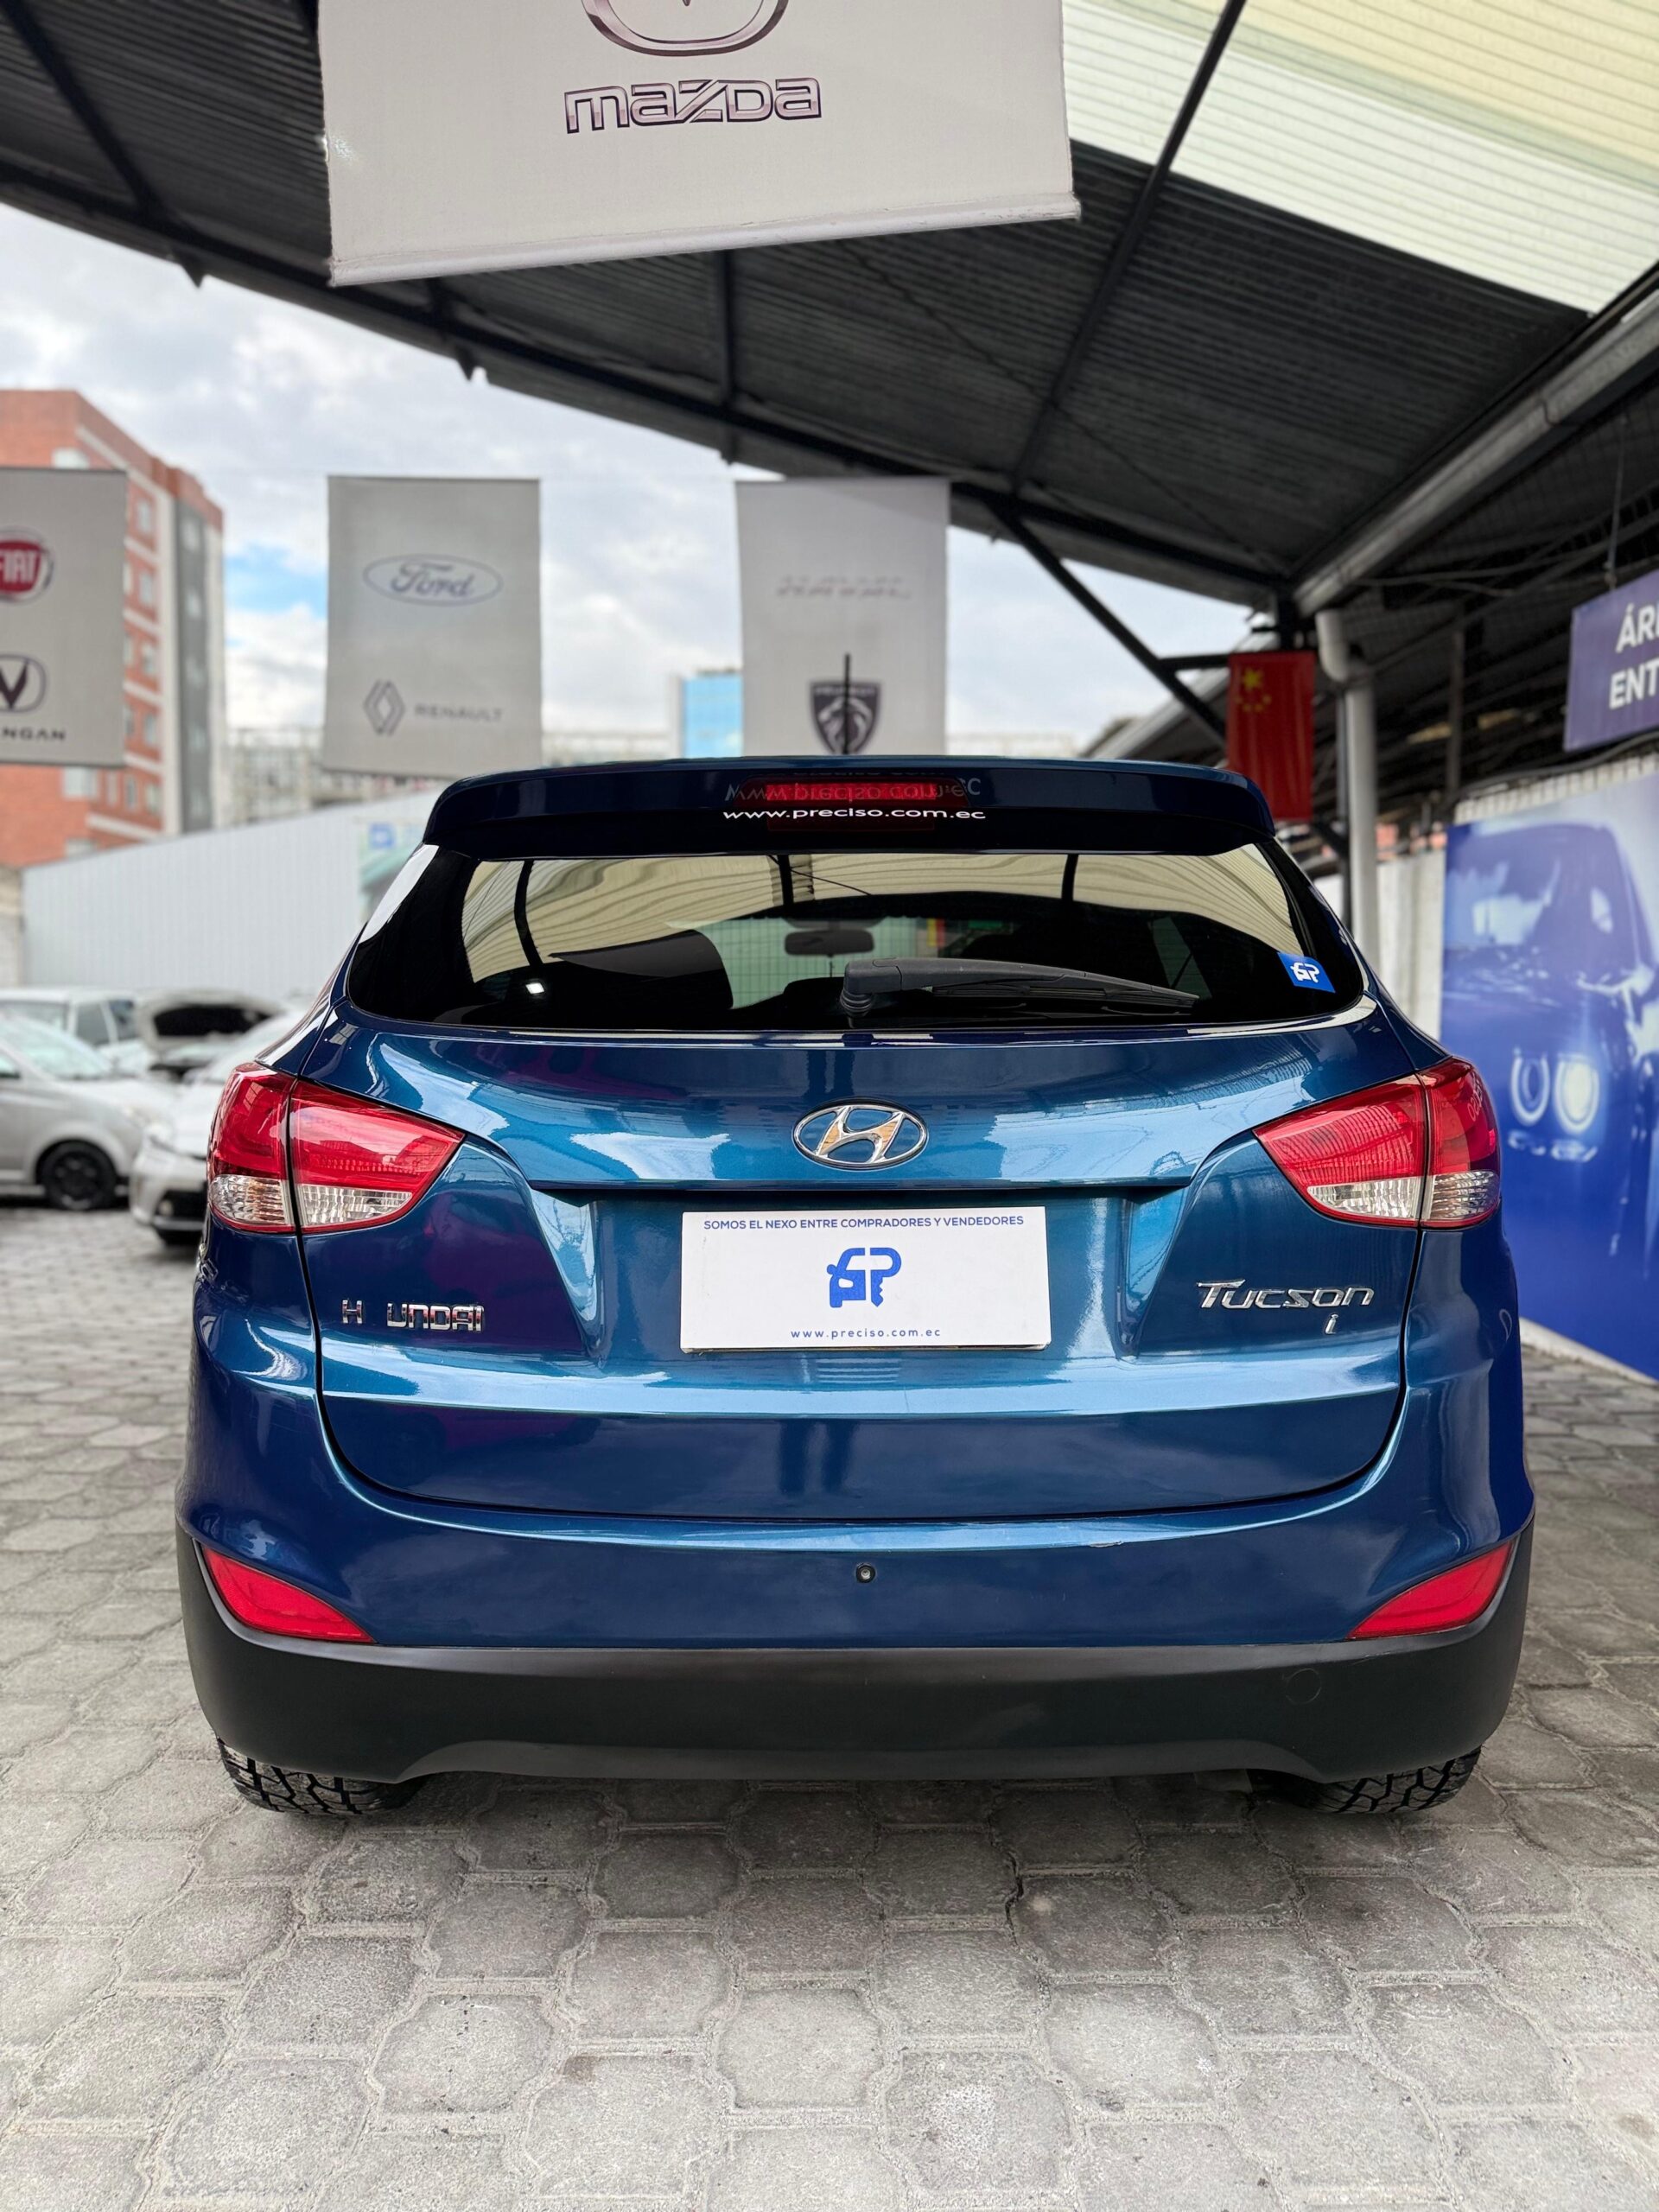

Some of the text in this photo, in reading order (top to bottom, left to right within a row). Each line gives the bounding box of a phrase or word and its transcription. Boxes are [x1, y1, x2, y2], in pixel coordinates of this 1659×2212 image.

[391, 561, 475, 596] Ford
[1615, 603, 1659, 653] ÁR
[722, 807, 986, 820] www.preciso.com.ec
[703, 1220, 746, 1230] SOMOS
[749, 1220, 763, 1229] EL
[800, 1219, 838, 1228] ENTRE
[841, 1217, 931, 1228] COMPRADORES
[934, 1217, 941, 1226] Y
[944, 1216, 1024, 1226] VENDEDORES
[1196, 1279, 1375, 1309] Tucson
[791, 1327, 941, 1339] www.preciso.com.ec
